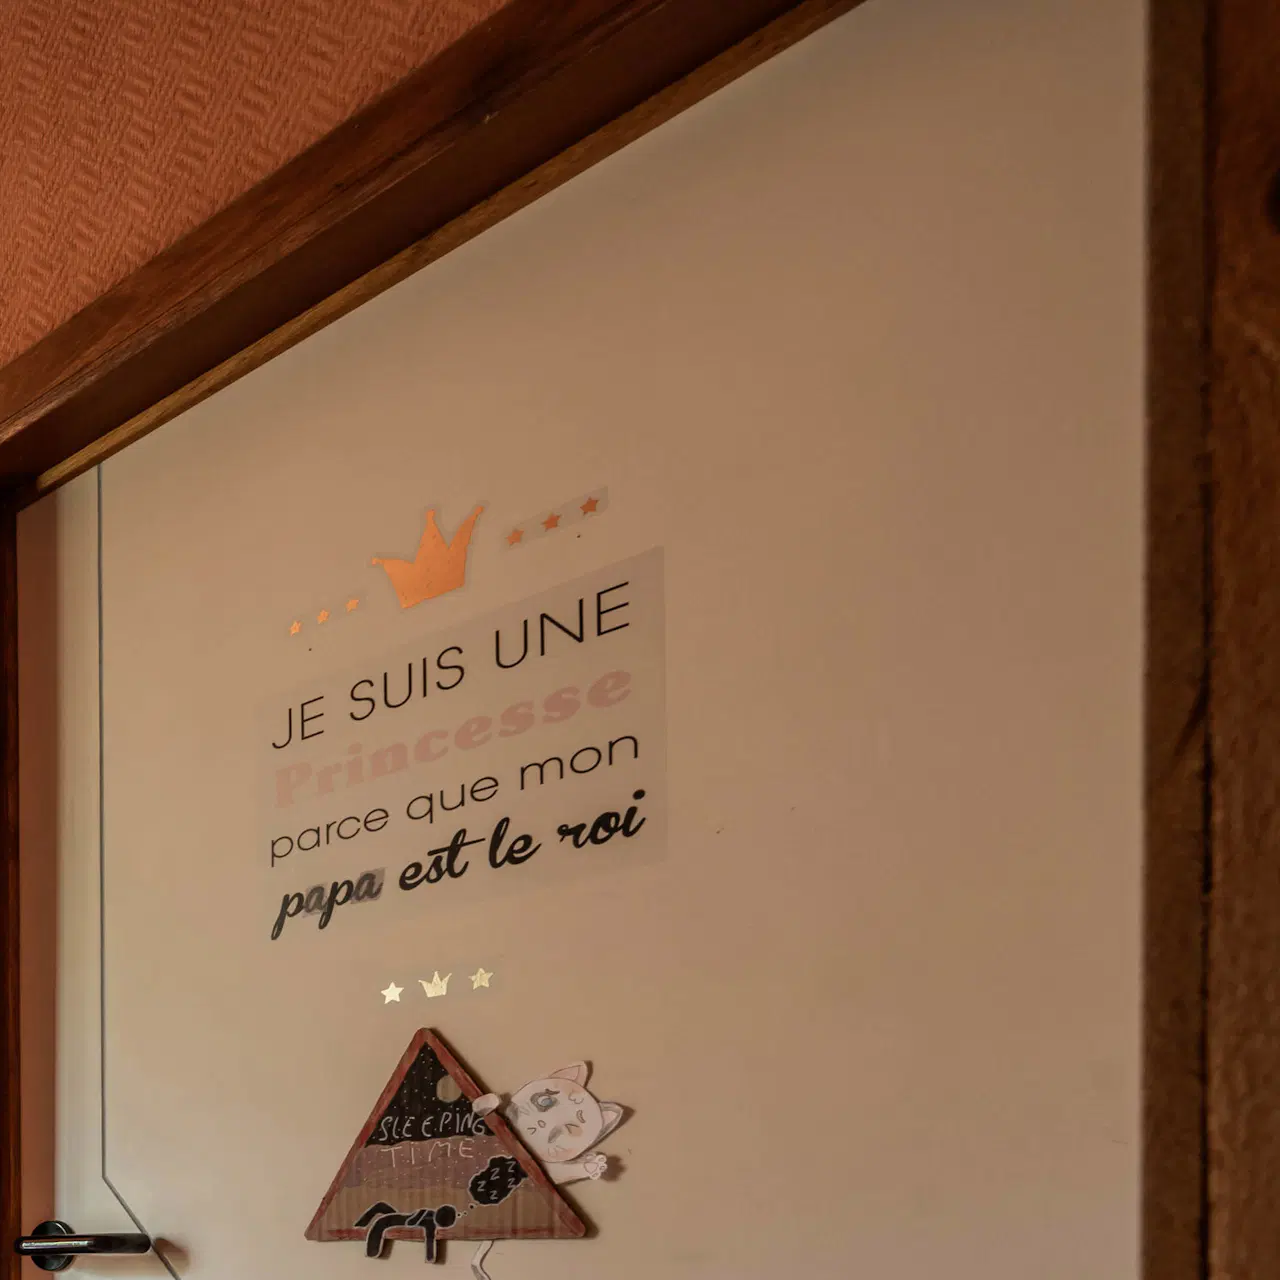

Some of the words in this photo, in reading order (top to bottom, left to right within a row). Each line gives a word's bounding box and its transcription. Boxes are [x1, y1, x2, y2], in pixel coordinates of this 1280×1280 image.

[272, 696, 325, 750] JE
[349, 645, 465, 721] SUIS
[495, 581, 630, 669] UNE
[270, 807, 389, 867] parce
[405, 776, 499, 824] que
[519, 735, 639, 791] mon
[274, 669, 632, 809] Princesse
[270, 872, 384, 940] papa
[398, 828, 486, 891] est
[488, 816, 543, 869] le
[557, 789, 646, 848] roi
[378, 1111, 486, 1141] SLEEPING
[380, 1138, 475, 1169] TIME
